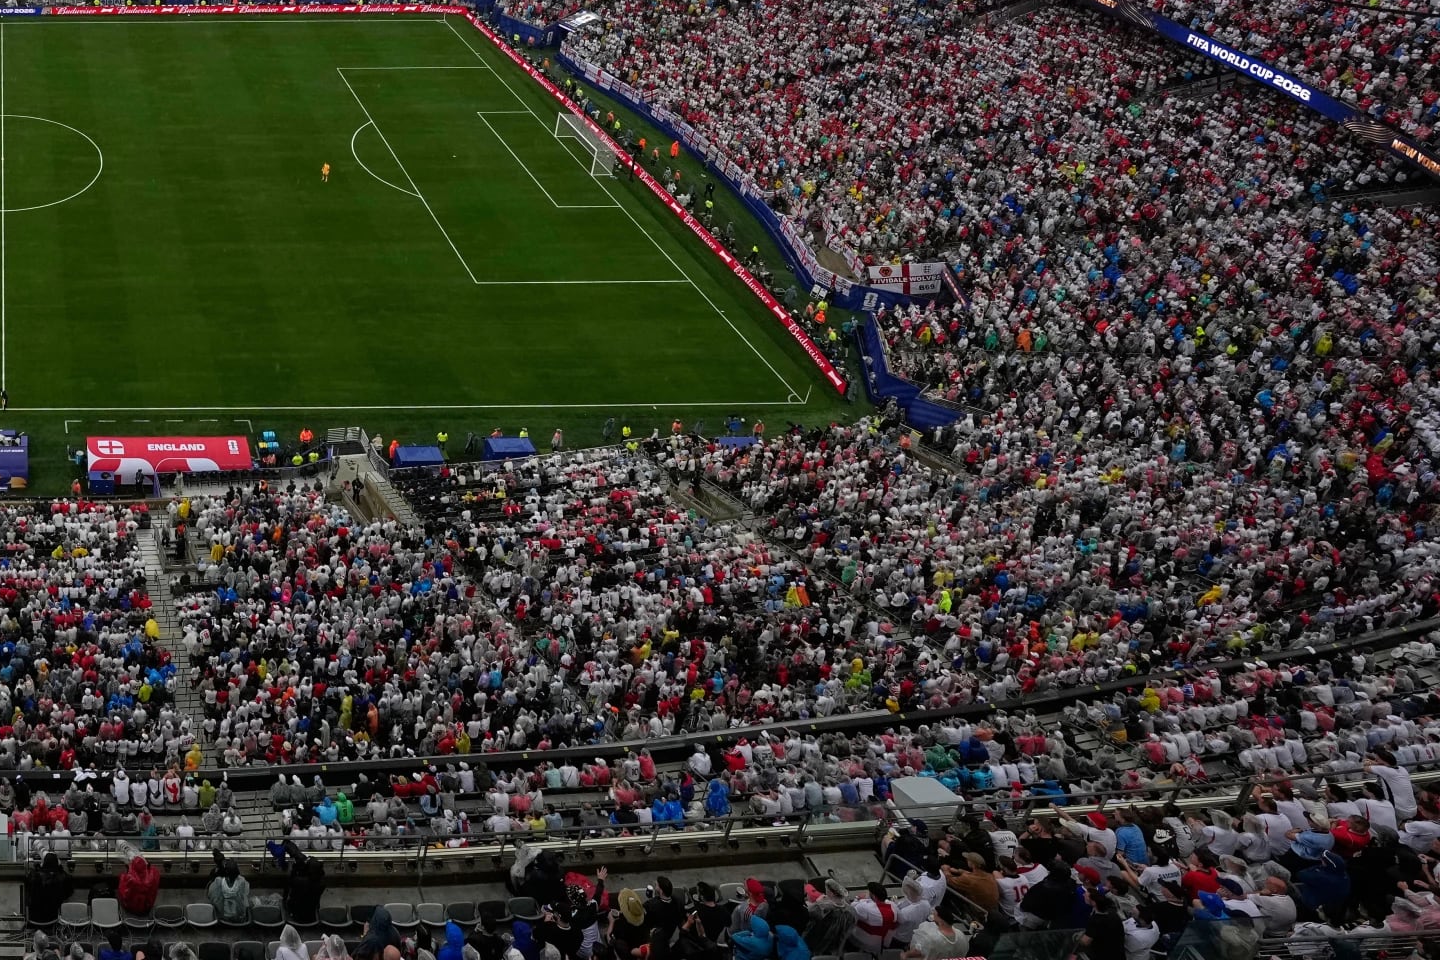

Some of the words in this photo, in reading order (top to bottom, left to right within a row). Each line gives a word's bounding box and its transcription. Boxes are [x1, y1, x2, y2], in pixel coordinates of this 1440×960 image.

[56, 7, 97, 15] Budweiser
[117, 6, 158, 14] Budweiser
[178, 6, 218, 14] Budweiser
[238, 5, 279, 14] Budweiser
[299, 5, 340, 14] Budweiser
[359, 5, 400, 14] Budweiser
[500, 40, 522, 66] Budweiser
[1186, 33, 1209, 53] FIFA
[1210, 41, 1250, 70] WORLD
[1249, 63, 1274, 80] CUP
[1272, 74, 1312, 101] 2026
[531, 68, 555, 94] Budweiser
[1391, 138, 1418, 159] NEW
[638, 169, 670, 203] Budweiser
[683, 211, 717, 250] Budweiser
[733, 261, 771, 305] Budweiser
[872, 276, 908, 285] TIVIDALE
[909, 274, 942, 282] WOLVES
[788, 317, 826, 369] Budweiser
[147, 443, 206, 452] ENGLAND
